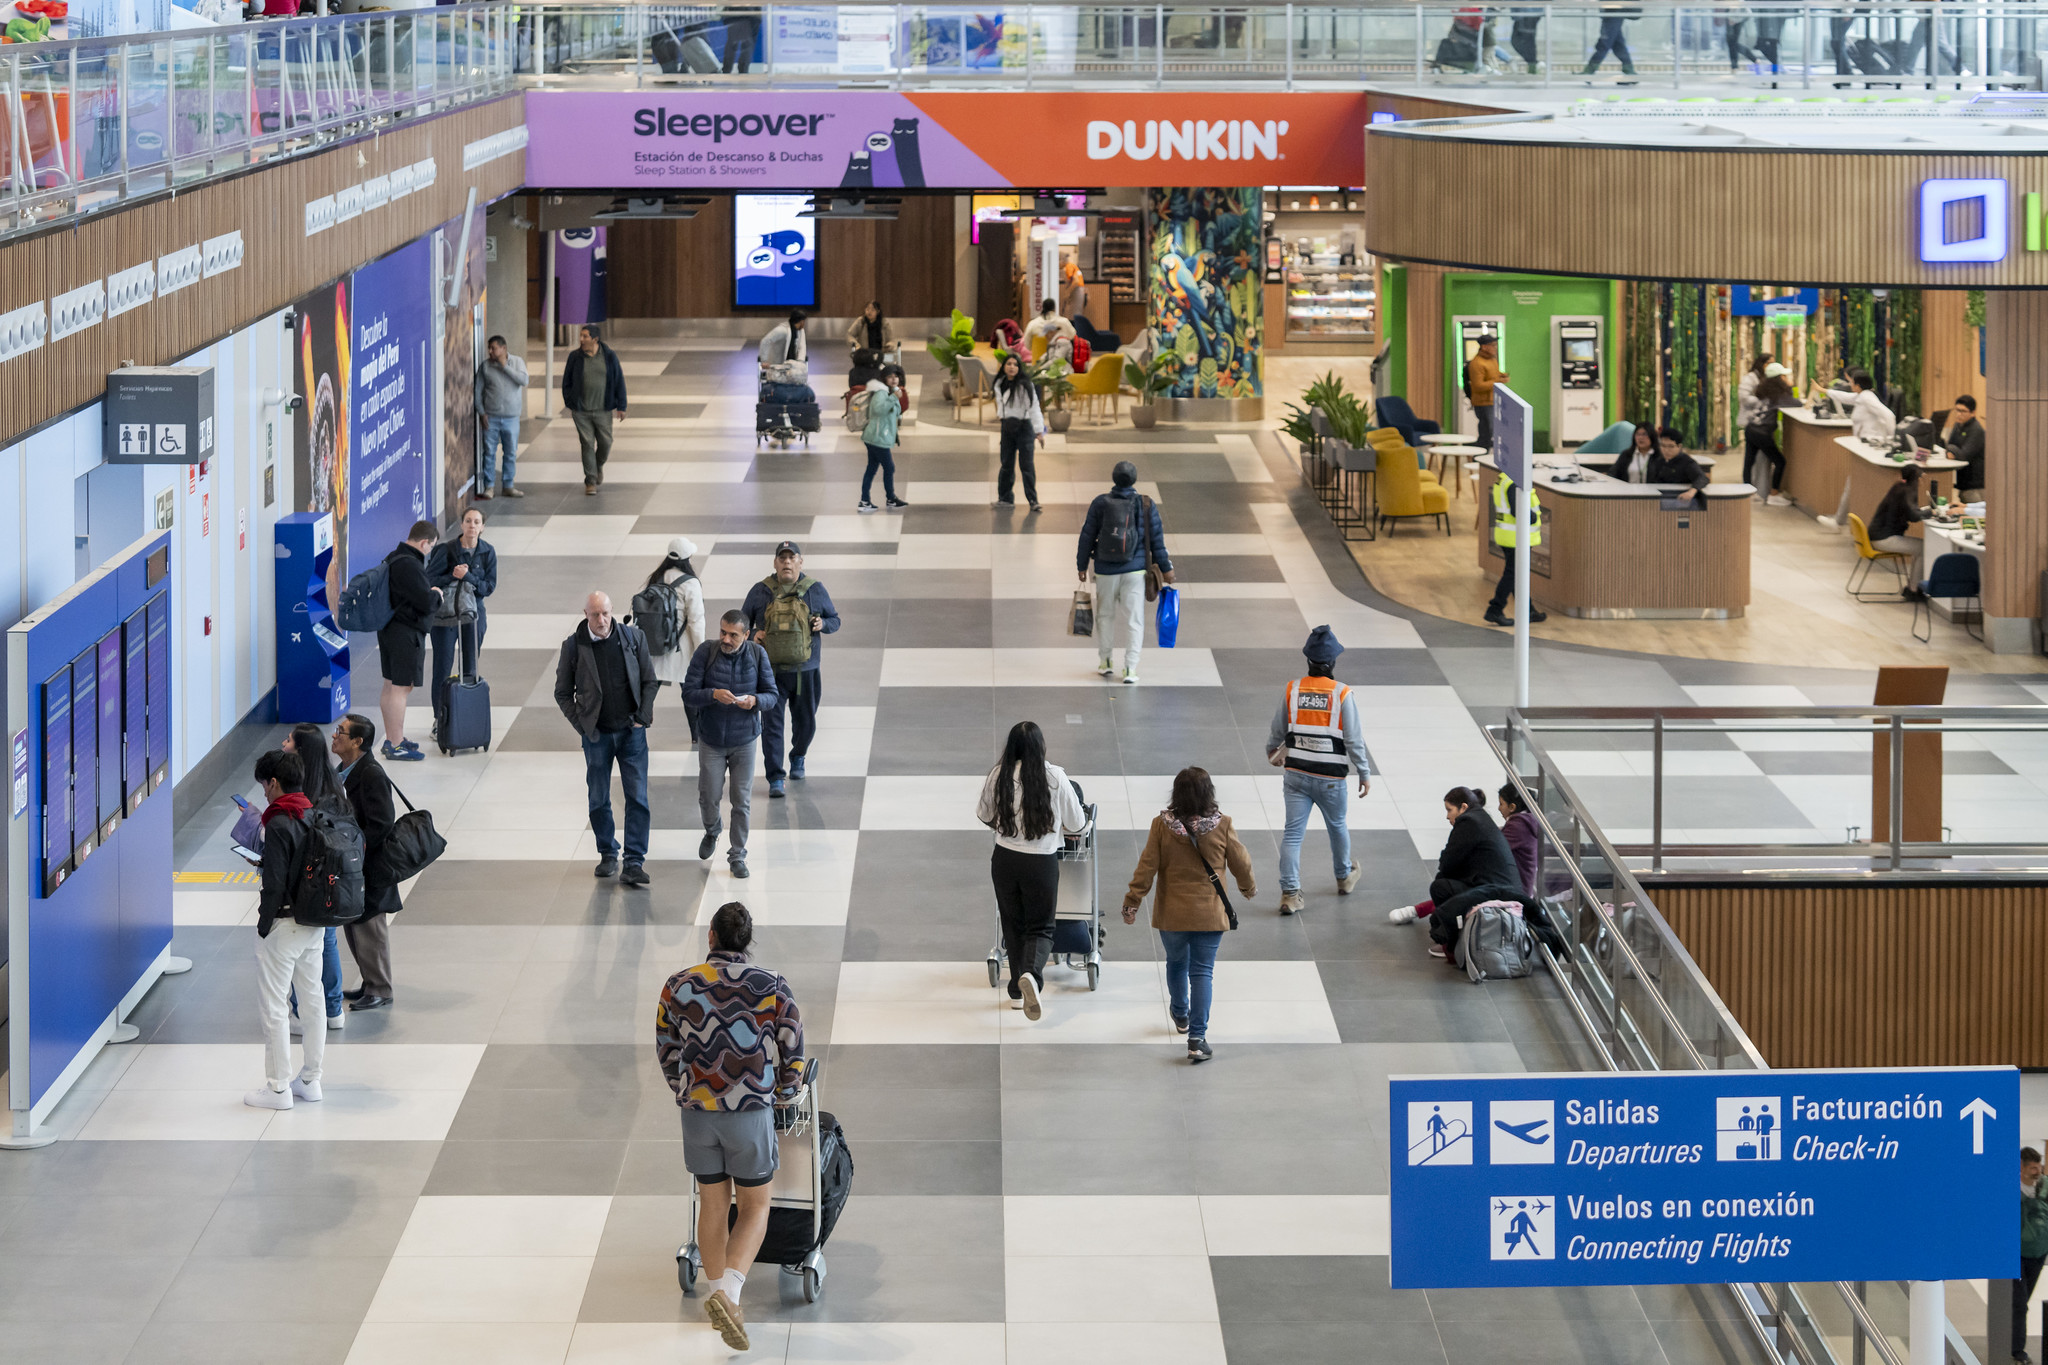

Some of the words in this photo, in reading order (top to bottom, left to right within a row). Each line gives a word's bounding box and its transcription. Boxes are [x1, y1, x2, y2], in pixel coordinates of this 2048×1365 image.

[634, 151, 684, 162] Estación
[688, 151, 703, 162] de
[707, 151, 764, 162] Descanso
[768, 152, 776, 162] &
[780, 151, 824, 162] Duchas
[1086, 119, 1290, 161] DUNKIN'
[634, 165, 665, 177] Sleep
[669, 165, 706, 175] Station
[710, 166, 717, 175] &
[720, 165, 767, 175] Showers
[2026, 192, 2048, 252] I
[1034, 272, 1042, 312] ORDENA
[360, 316, 383, 352] Descubre
[382, 311, 388, 338] la
[360, 352, 378, 390] magia
[378, 344, 387, 375] del
[387, 337, 400, 369] Perú
[380, 373, 397, 414] espacio
[360, 429, 377, 459] Nuevo
[376, 420, 390, 453] Jorge
[1566, 1099, 1660, 1126] Salidas
[1791, 1093, 1943, 1121] Facturación
[1566, 1139, 1703, 1170] Departures
[1792, 1134, 1900, 1161] Check-in
[1566, 1194, 1653, 1220] Vuelos
[1662, 1199, 1691, 1220] en
[1701, 1191, 1815, 1219] conexión
[1566, 1234, 1704, 1265] Connecting
[1710, 1231, 1792, 1265] Flights
